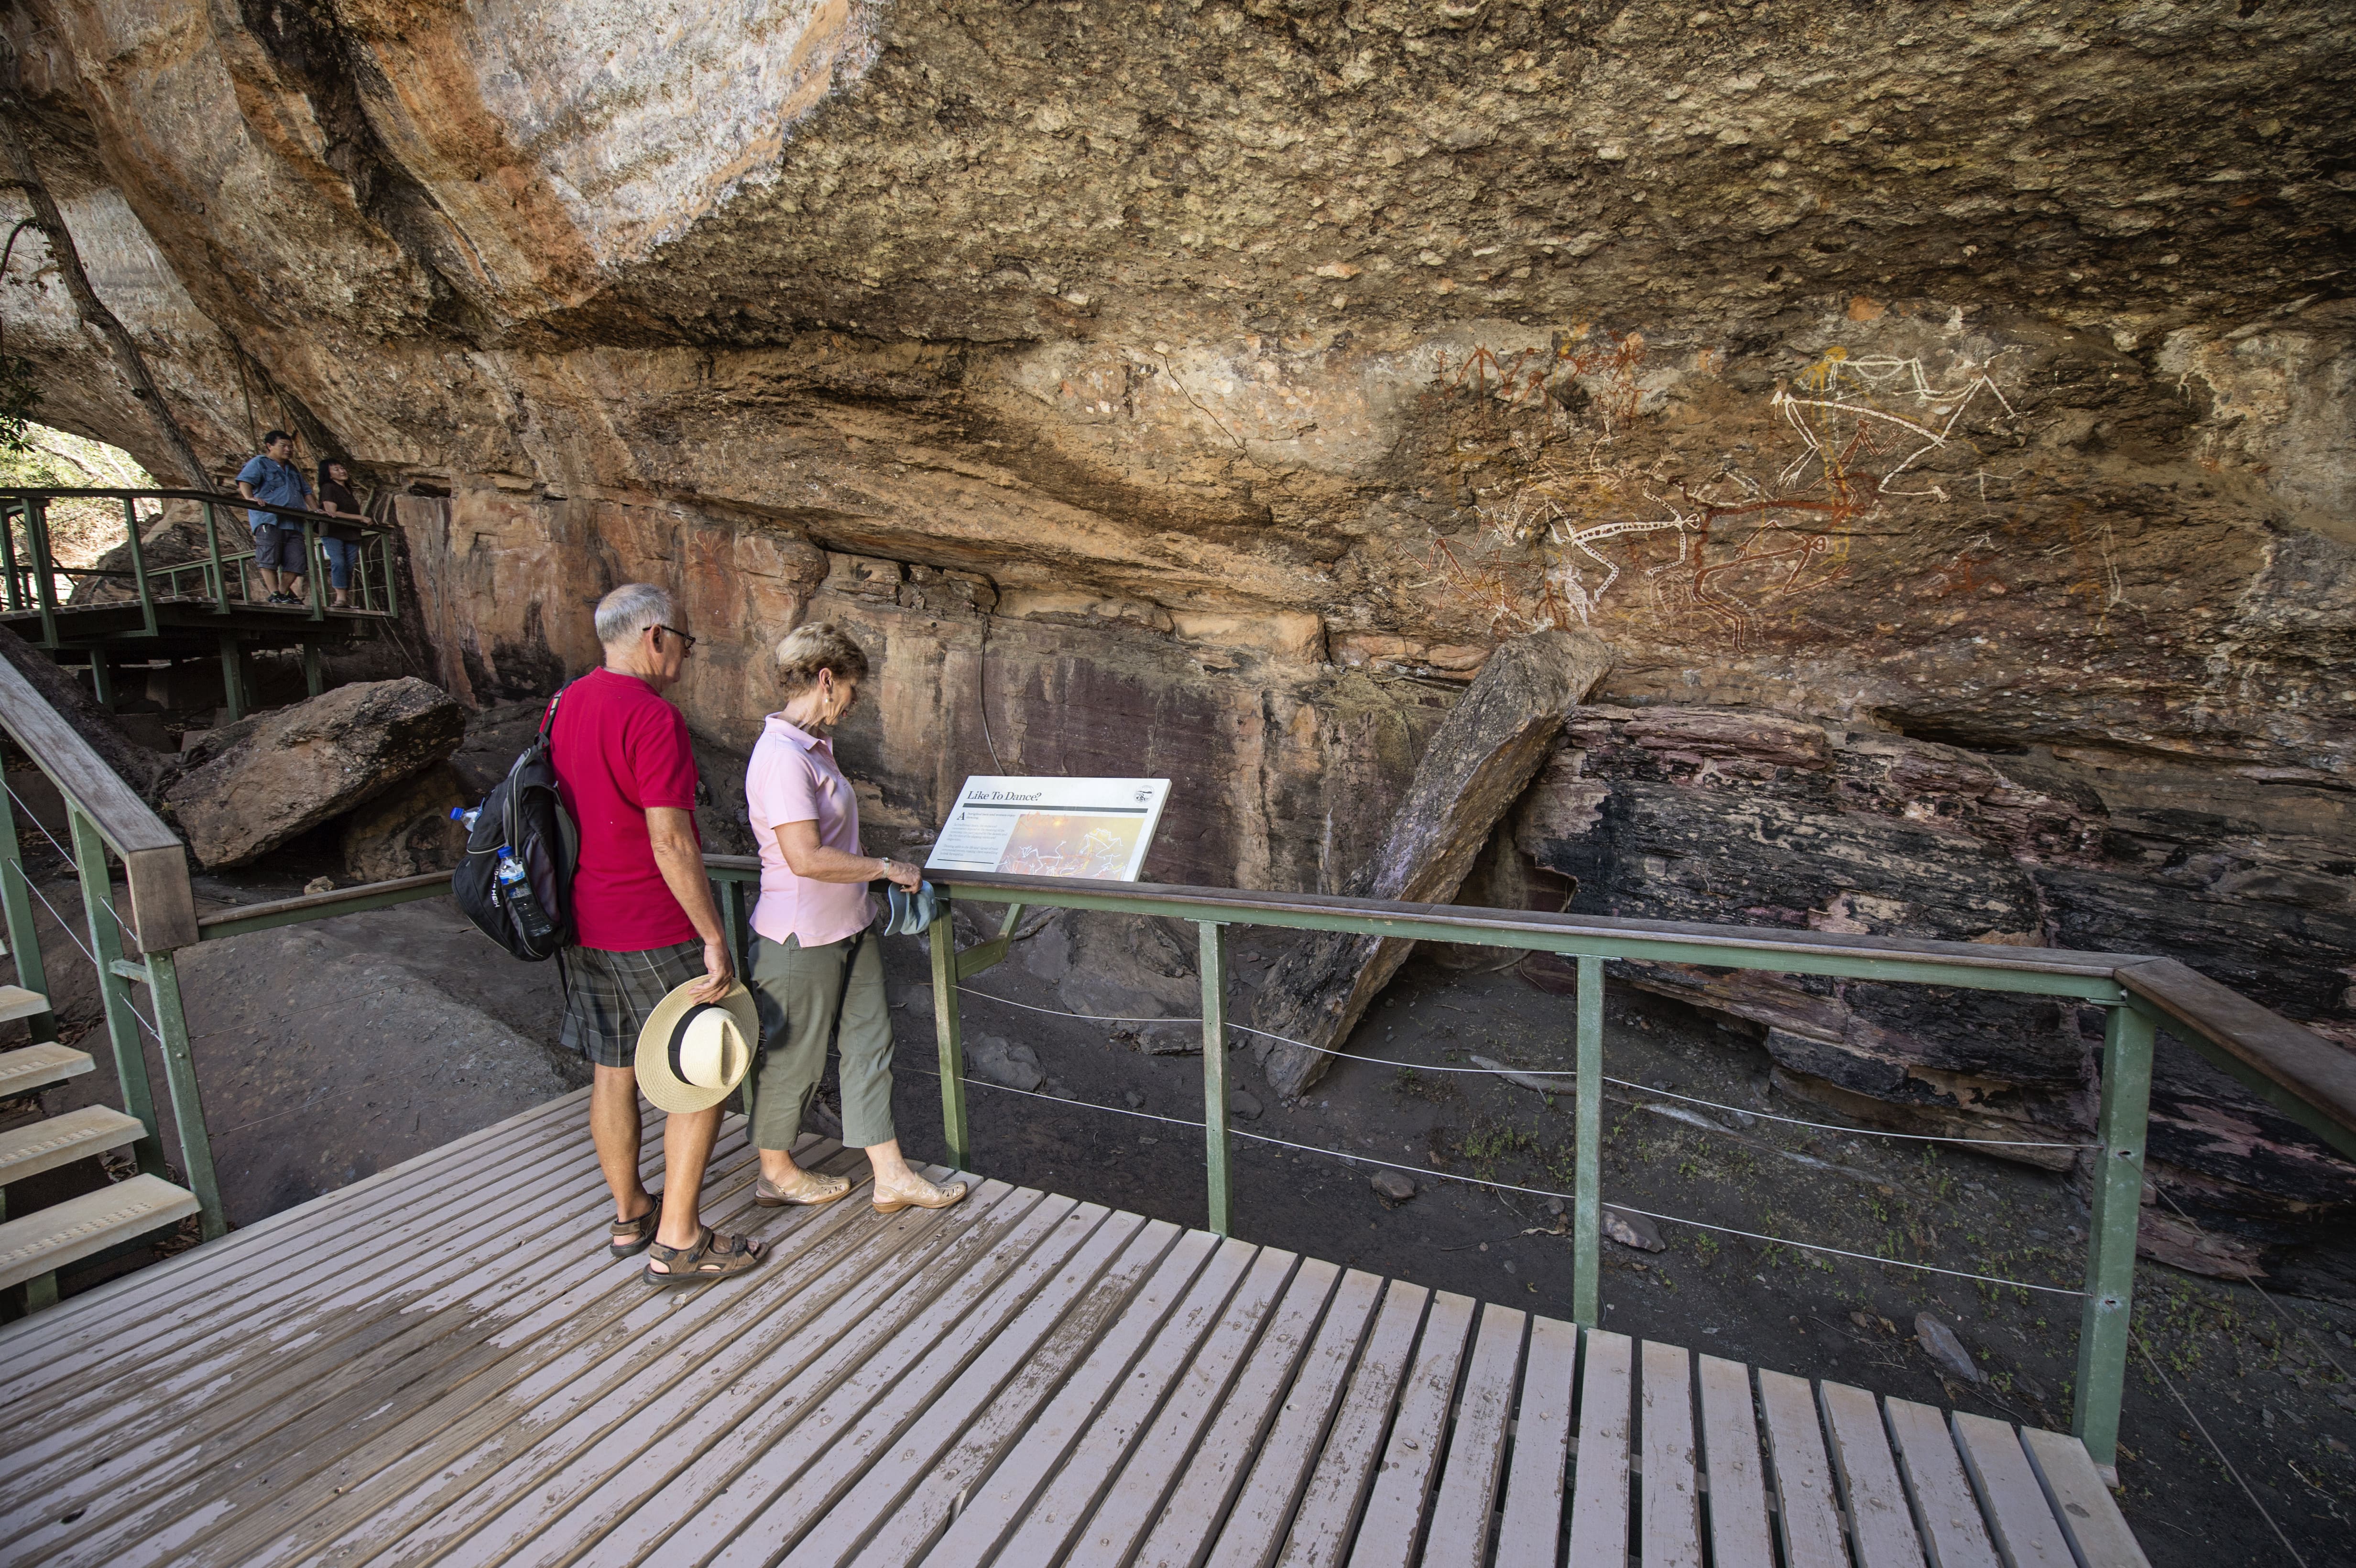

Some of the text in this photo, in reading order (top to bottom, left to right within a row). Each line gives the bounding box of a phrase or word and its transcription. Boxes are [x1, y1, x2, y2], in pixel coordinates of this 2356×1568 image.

[966, 791, 1042, 801] Like To Dance?
